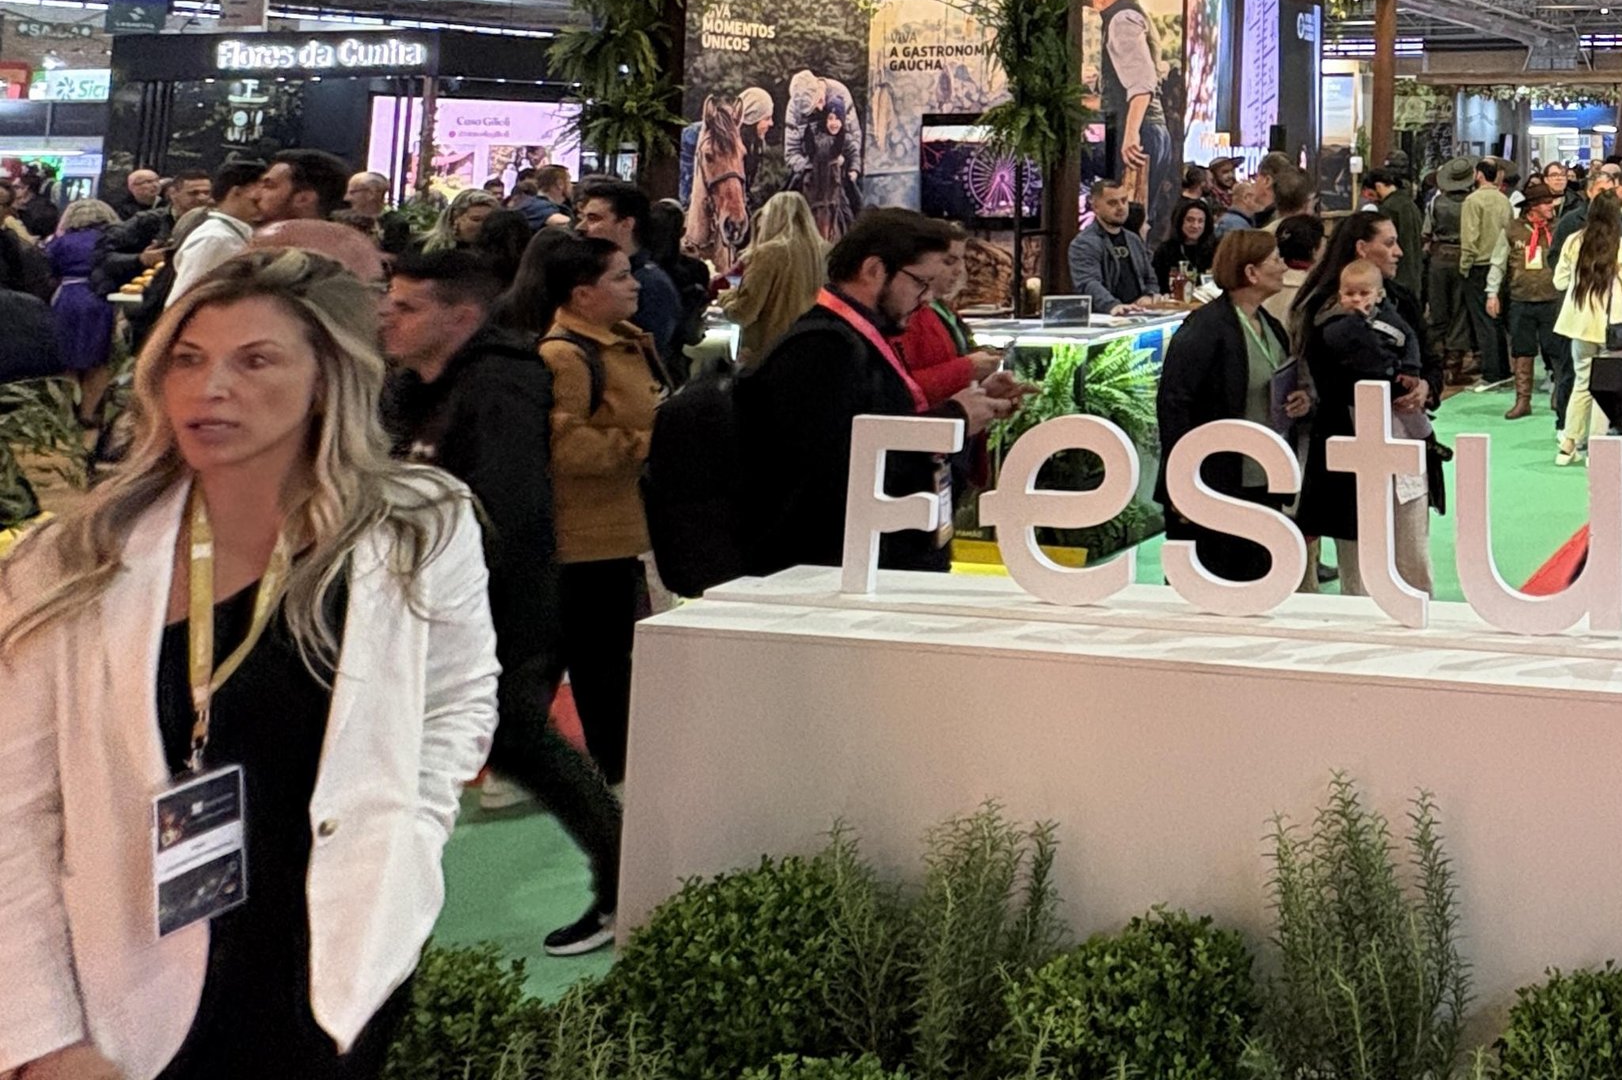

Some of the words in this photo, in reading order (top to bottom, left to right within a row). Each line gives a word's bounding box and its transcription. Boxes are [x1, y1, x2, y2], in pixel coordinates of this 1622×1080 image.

[703, 17, 776, 38] MOMENTOS
[216, 39, 297, 69] Flores
[299, 39, 335, 67] da
[337, 38, 425, 67] Cunha
[889, 46, 899, 58] A
